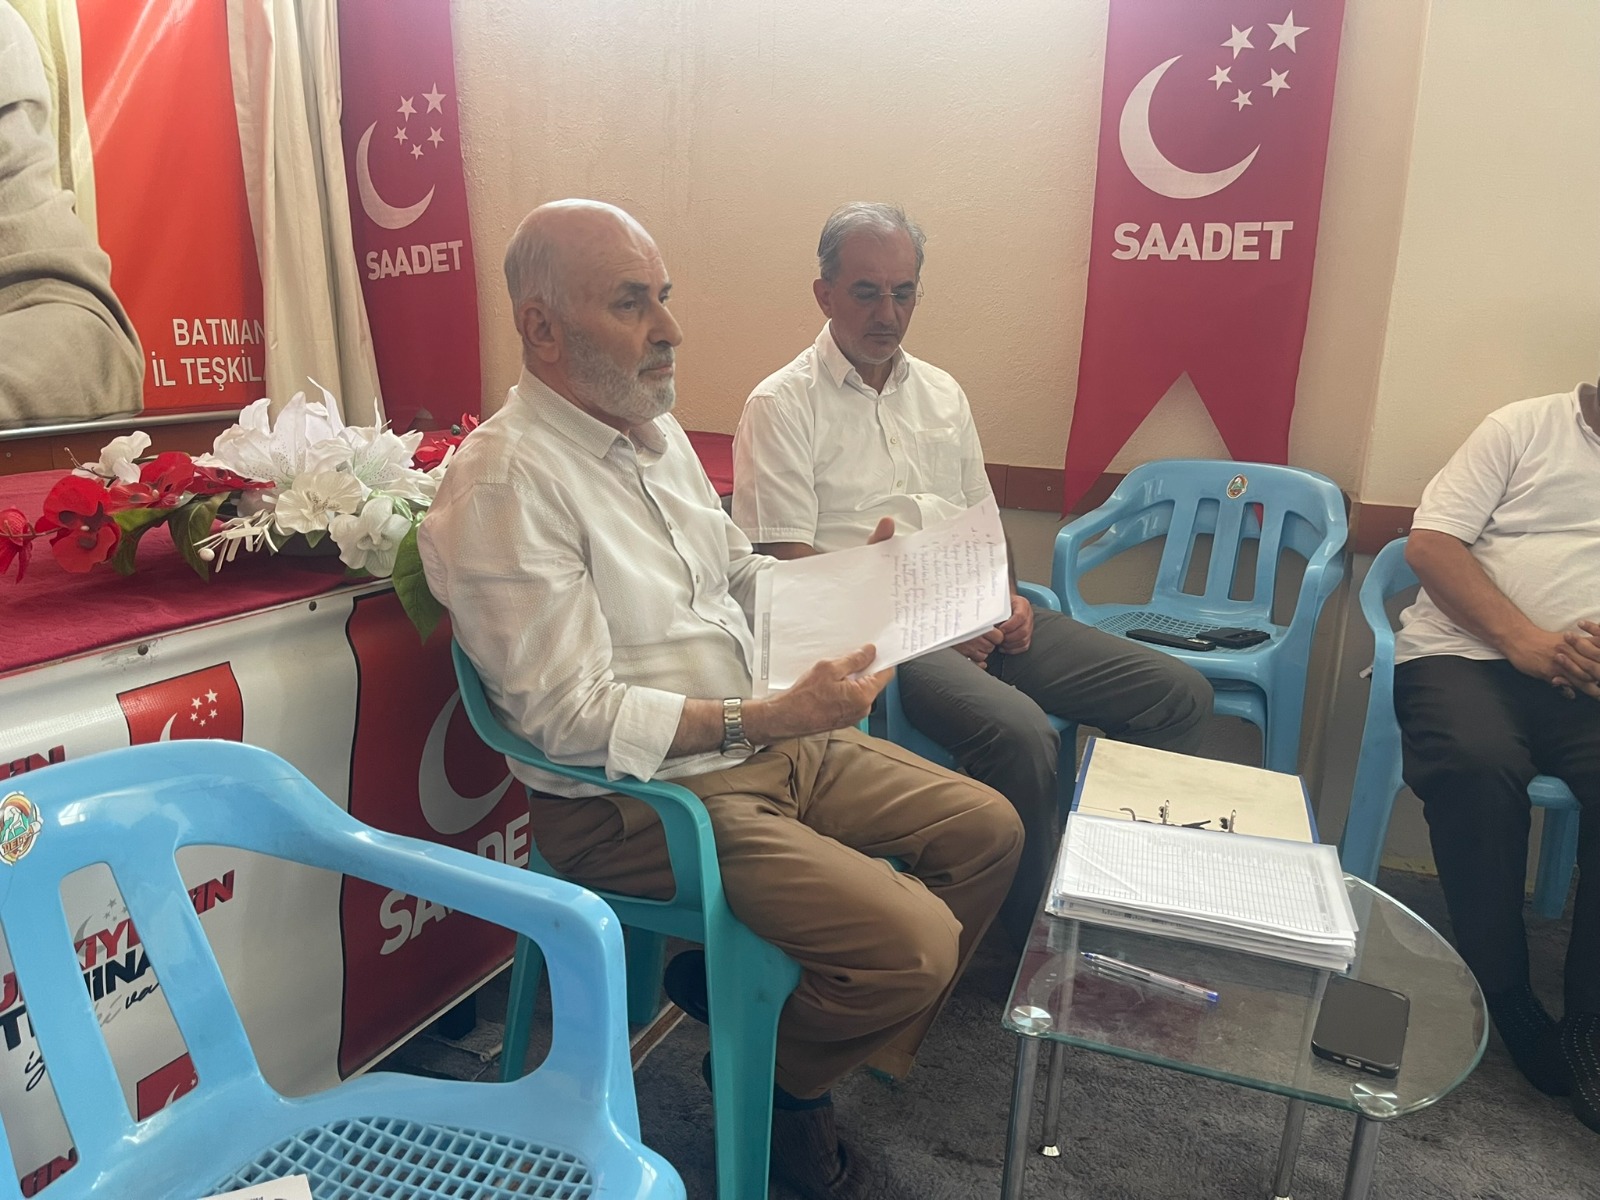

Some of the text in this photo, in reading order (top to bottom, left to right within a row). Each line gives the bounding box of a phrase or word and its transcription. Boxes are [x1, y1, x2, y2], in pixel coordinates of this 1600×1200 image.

[365, 239, 463, 281] SAADET
[1111, 220, 1294, 261] SAADET
[173, 318, 265, 346] BATMAN
[151, 349, 266, 391] İL TEŞKİL
